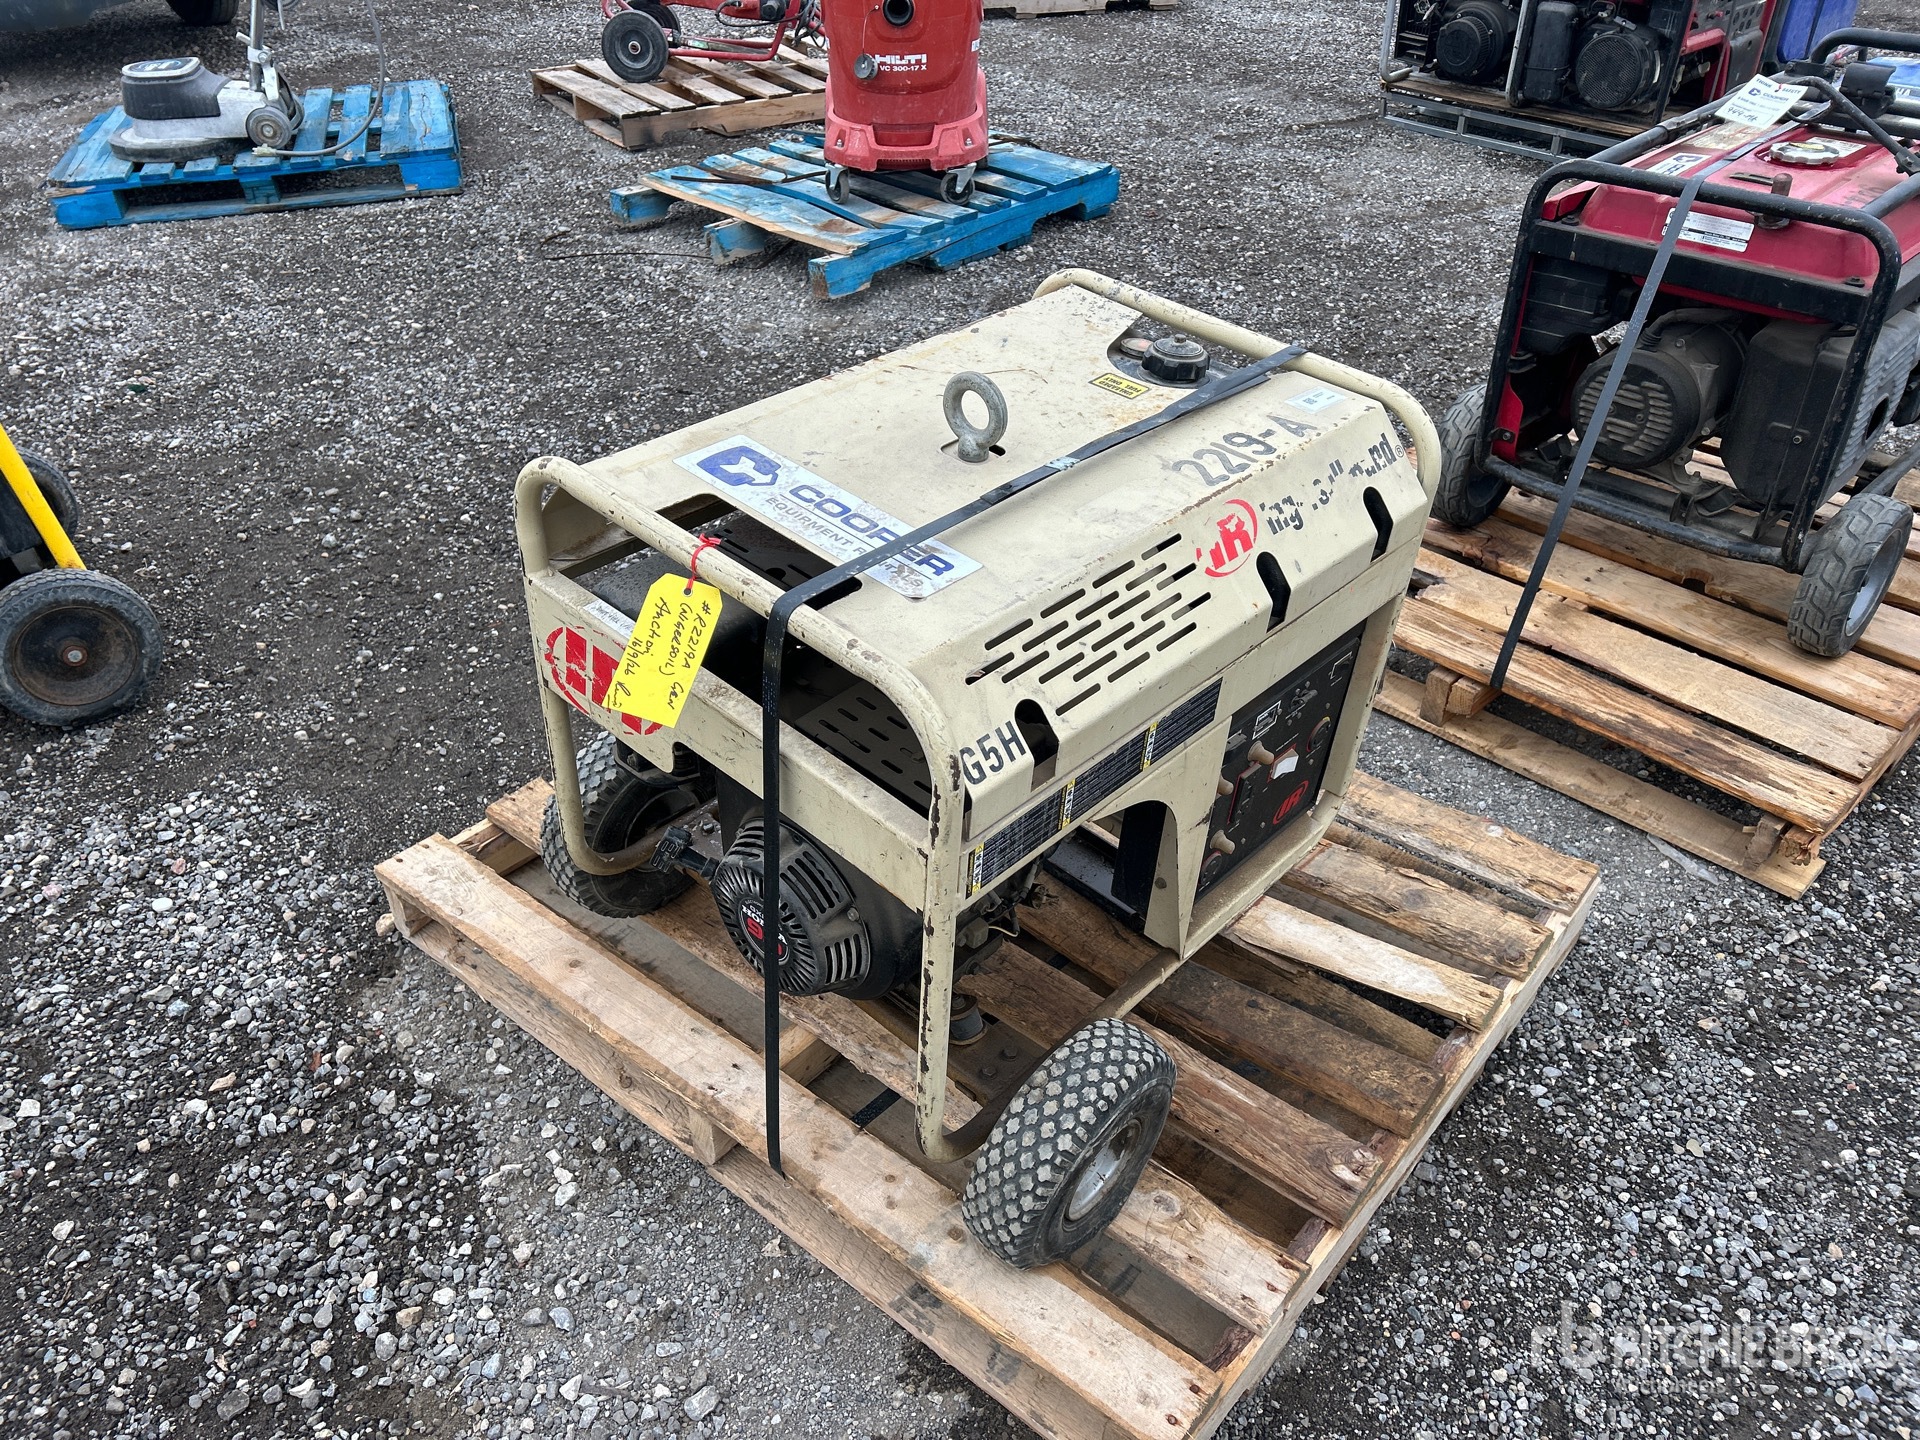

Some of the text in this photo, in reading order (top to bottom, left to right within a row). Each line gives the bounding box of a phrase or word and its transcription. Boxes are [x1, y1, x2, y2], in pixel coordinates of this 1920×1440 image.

[874, 54, 927, 65] HILTI
[766, 497, 924, 587] EQUIPMENT RNTALS
[789, 485, 954, 576] COOPER
[959, 720, 1026, 785] G5H
